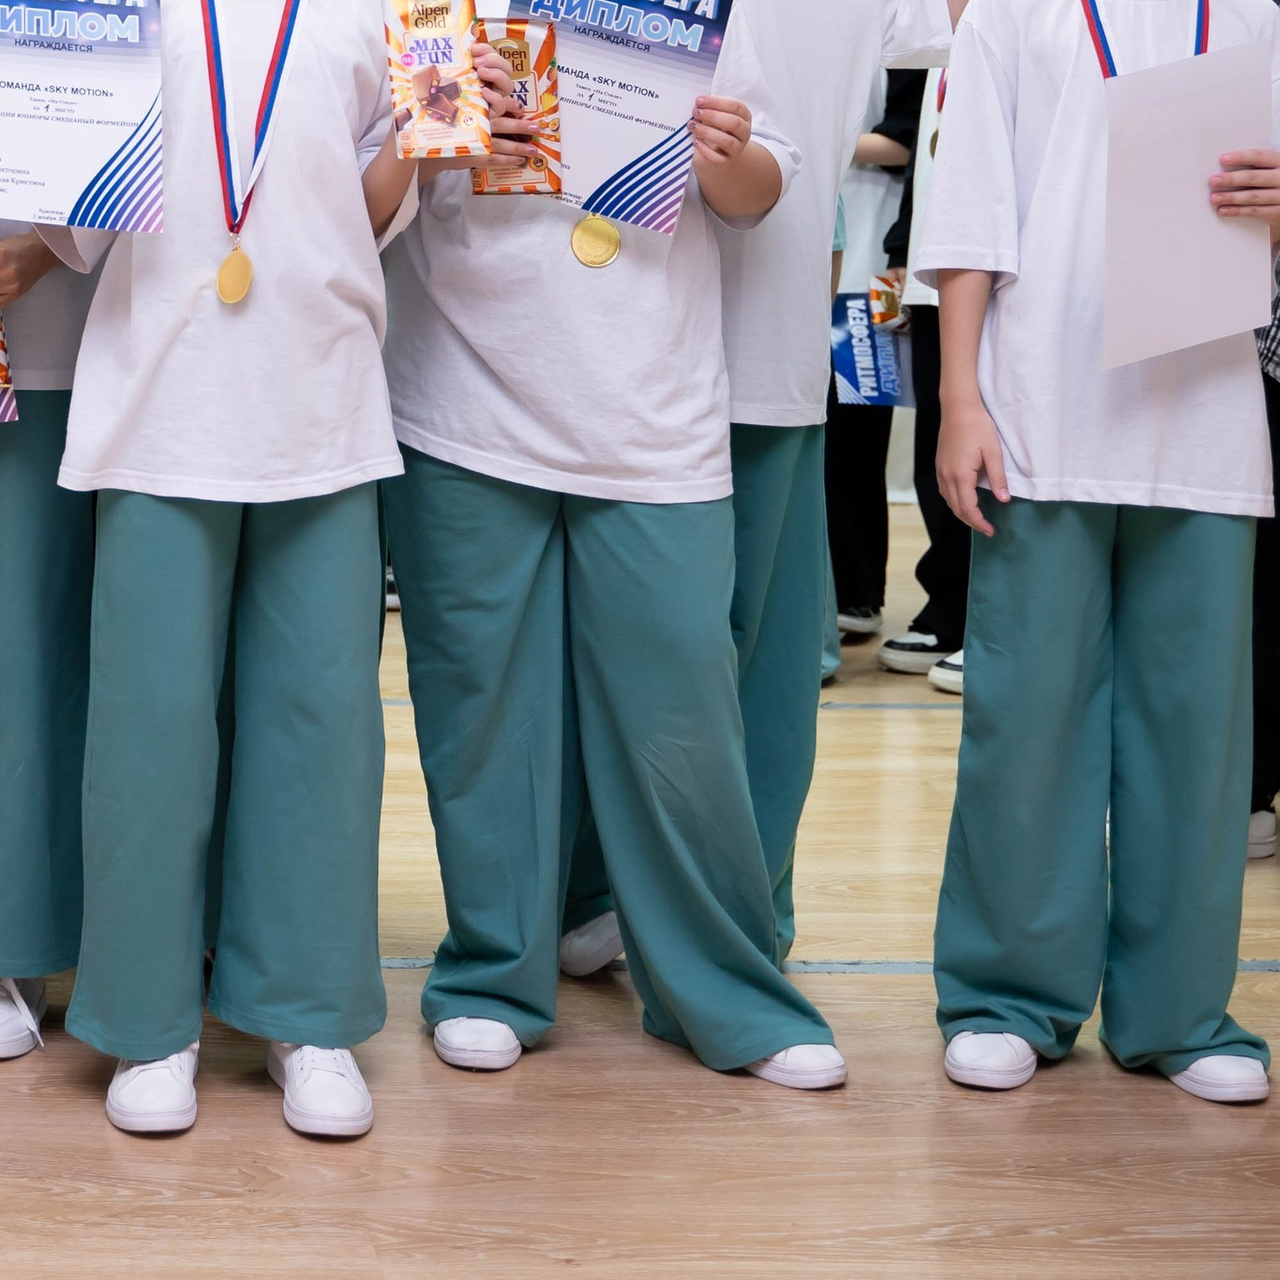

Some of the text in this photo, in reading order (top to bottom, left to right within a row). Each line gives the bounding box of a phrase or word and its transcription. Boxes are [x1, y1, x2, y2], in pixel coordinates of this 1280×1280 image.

[411, 3, 449, 20] Alpen
[414, 17, 446, 29] Gold
[15, 38, 93, 53] НАГРАЖДАЕТСЯ
[409, 36, 453, 53] MAX
[574, 25, 650, 53] НАГРАЖДАЕТСЯ
[416, 50, 453, 65] FUN
[493, 47, 527, 60] lpen
[557, 64, 659, 99] МАНДА «SKY MOTION»
[45, 85, 68, 94] «SKY
[71, 87, 114, 97] MOTION»
[846, 298, 878, 397] РИТМОСФЕРА
[875, 332, 901, 396] ДИПЛ
